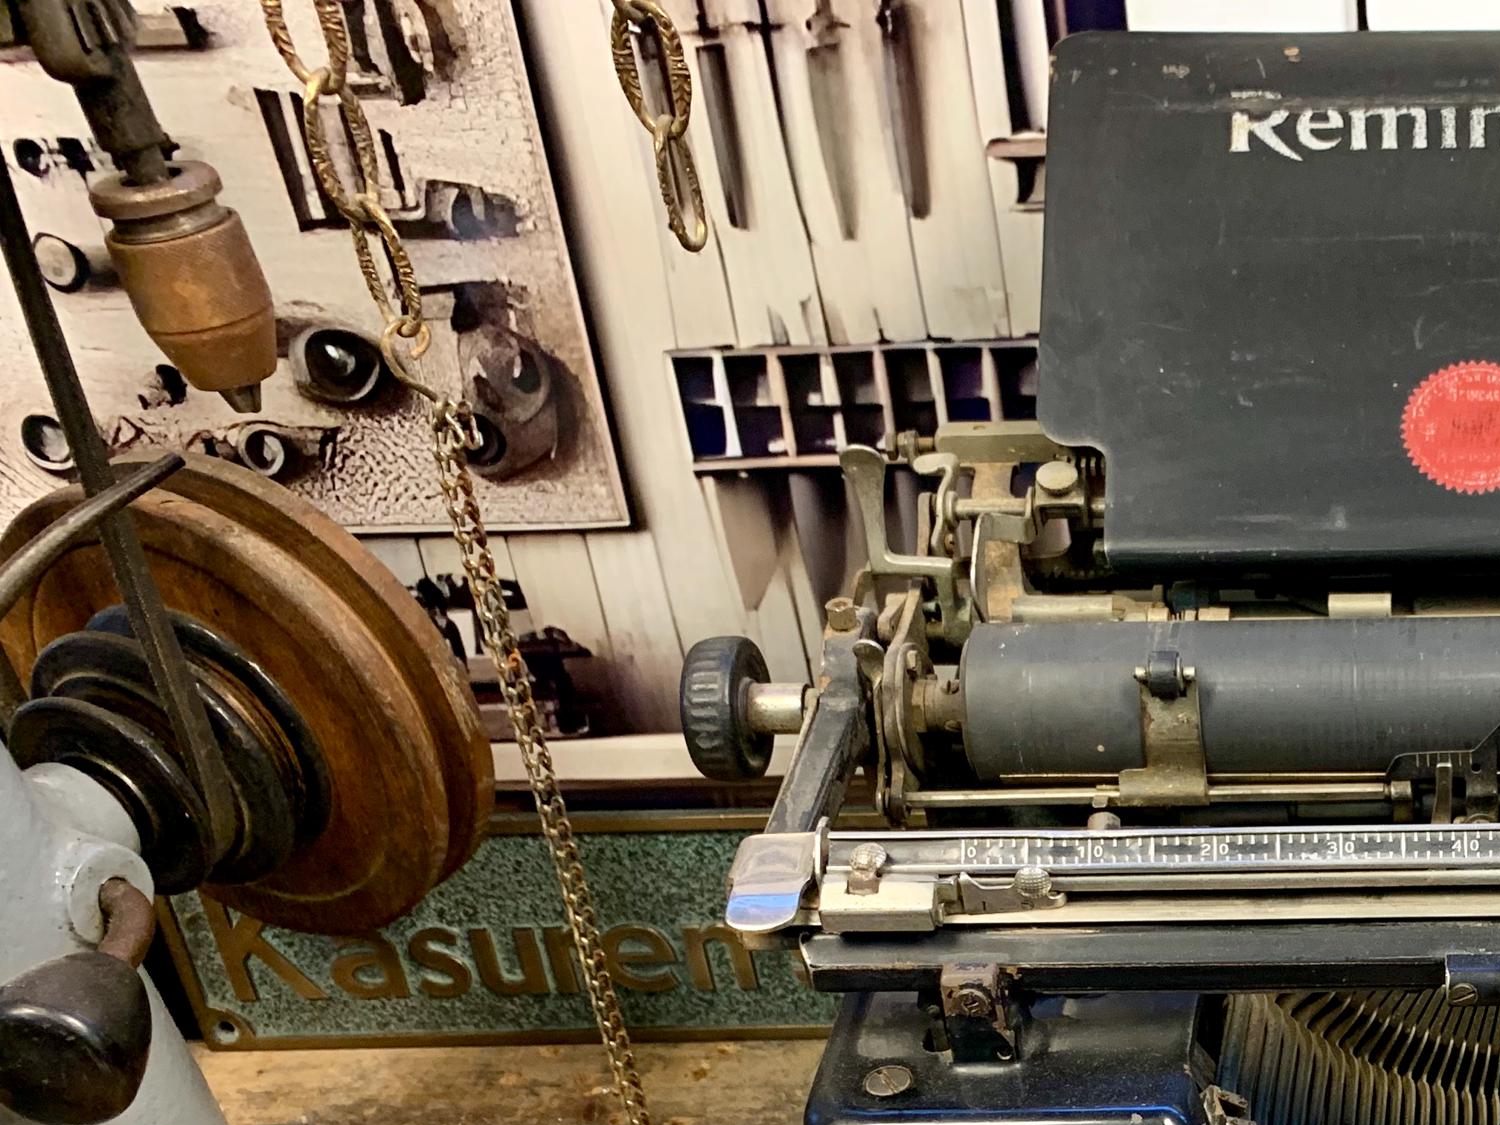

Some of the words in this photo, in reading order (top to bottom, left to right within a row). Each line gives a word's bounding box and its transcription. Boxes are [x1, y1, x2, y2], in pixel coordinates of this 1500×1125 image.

[1200, 843, 1230, 857] 20
[1326, 841, 1356, 855] 30
[1452, 839, 1480, 853] 40
